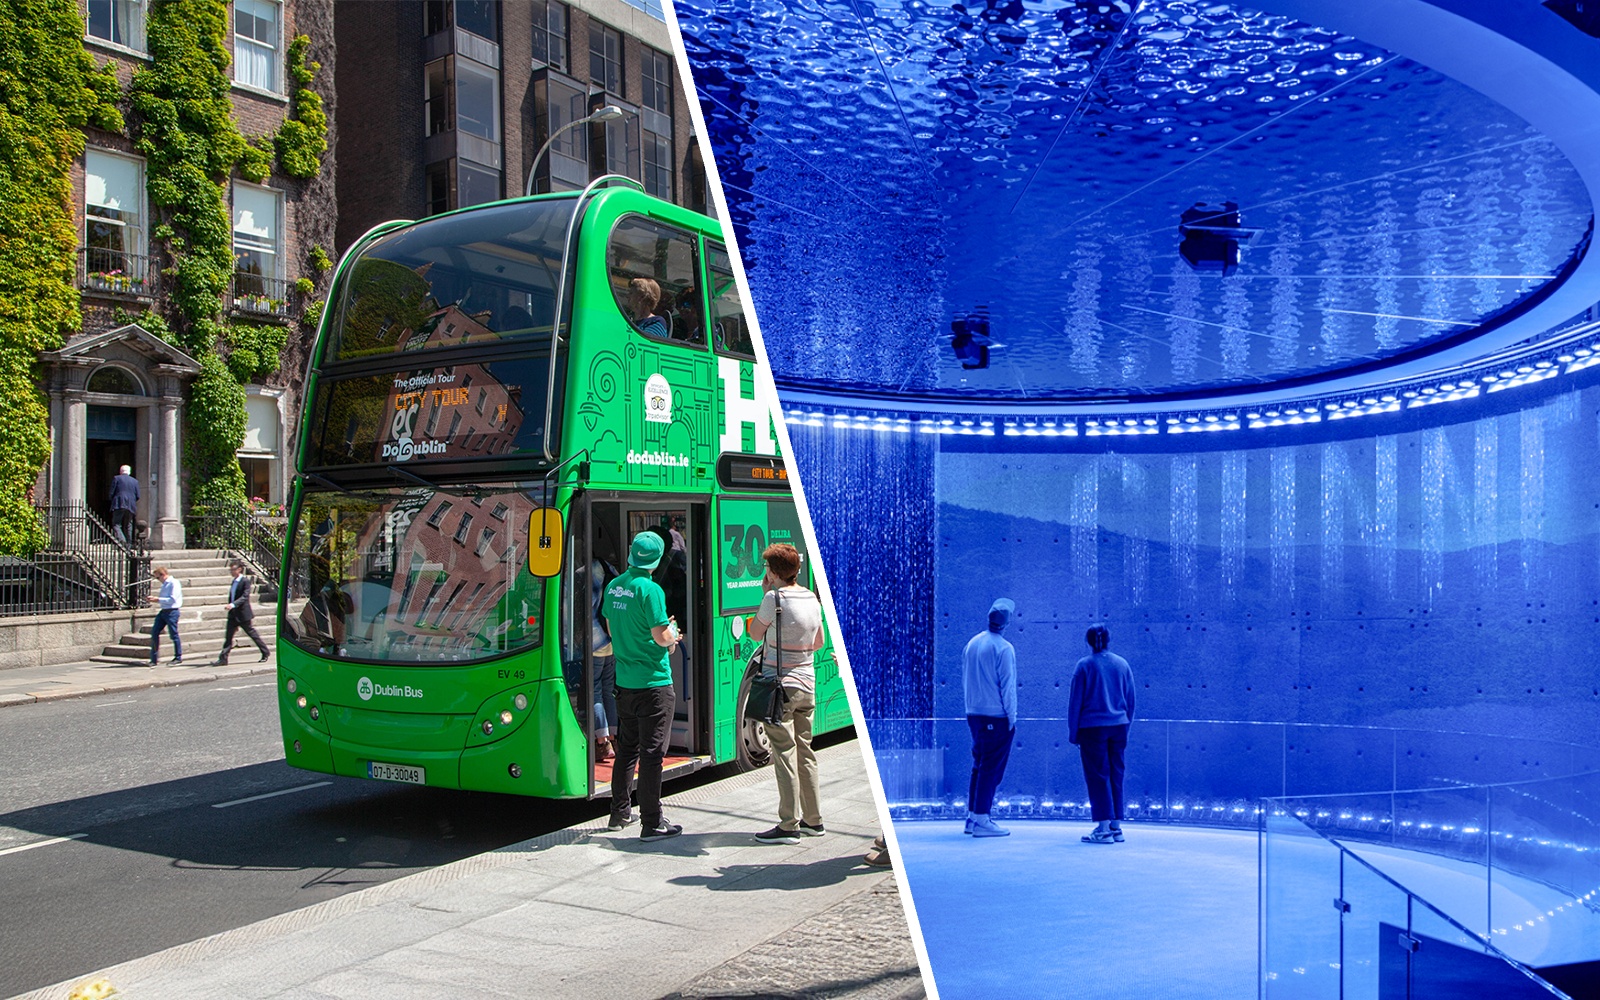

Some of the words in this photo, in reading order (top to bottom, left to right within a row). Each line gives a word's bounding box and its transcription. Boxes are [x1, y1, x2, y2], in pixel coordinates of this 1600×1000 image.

[394, 379, 408, 388] The
[409, 375, 436, 387] Official
[438, 374, 455, 384] Tour
[395, 391, 427, 411] CITY
[431, 387, 469, 407] TOUR
[382, 437, 447, 461] DoDublin
[627, 449, 689, 467] dodublin.ie
[724, 524, 766, 579] 30
[726, 581, 738, 589] YEAR
[497, 670, 510, 679] EV
[513, 670, 526, 679] 49
[374, 684, 403, 697] Dublin
[405, 685, 424, 698] Bus
[373, 765, 419, 782] 07-D-30049
